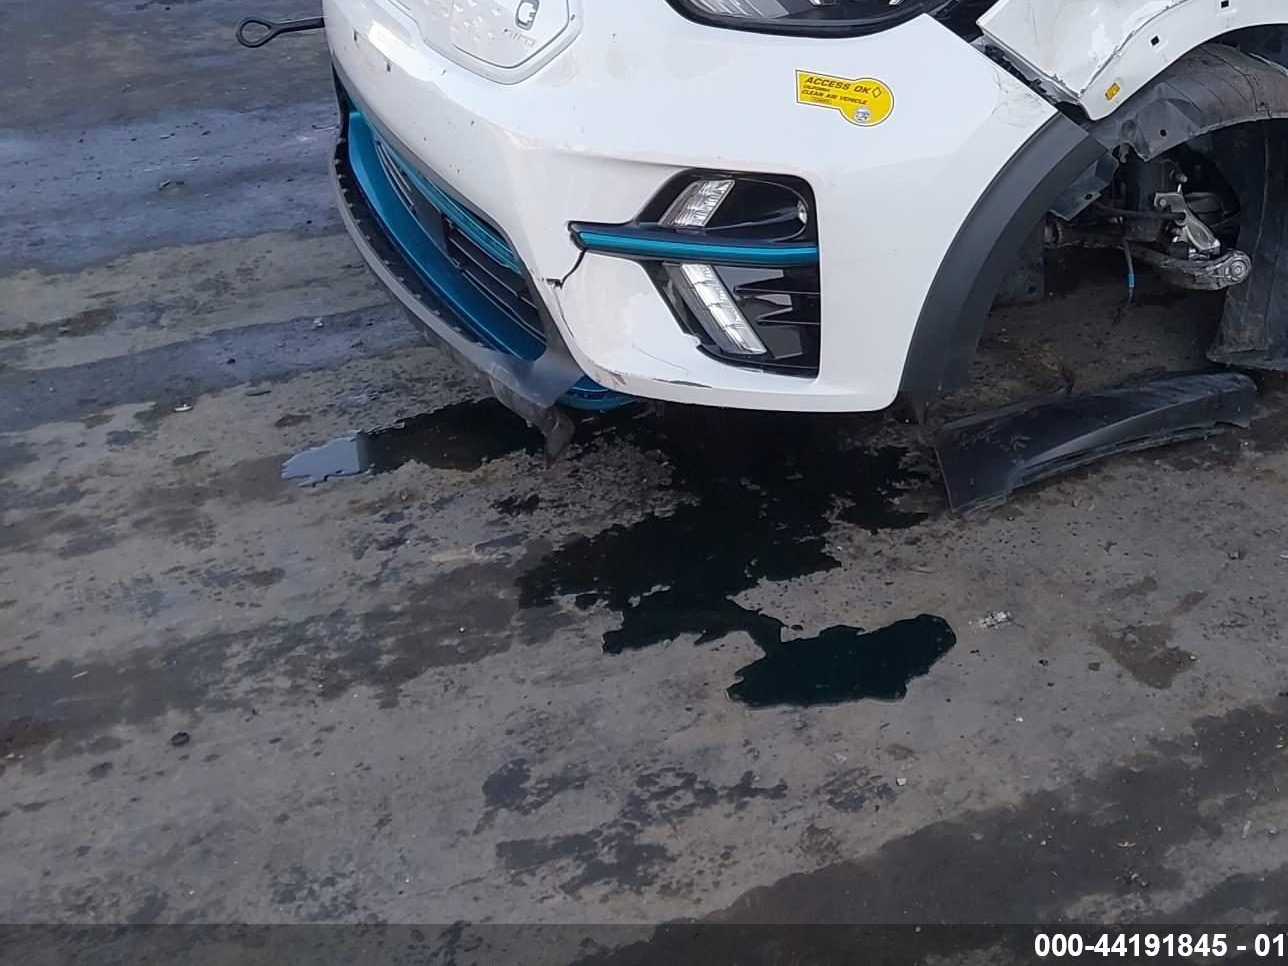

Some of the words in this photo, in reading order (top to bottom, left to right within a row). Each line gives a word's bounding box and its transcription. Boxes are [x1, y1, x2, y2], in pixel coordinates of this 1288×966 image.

[805, 77, 851, 90] ACCESS
[853, 85, 872, 94] OK
[801, 89, 825, 97] CLEAN
[840, 96, 868, 105] VEHICLE
